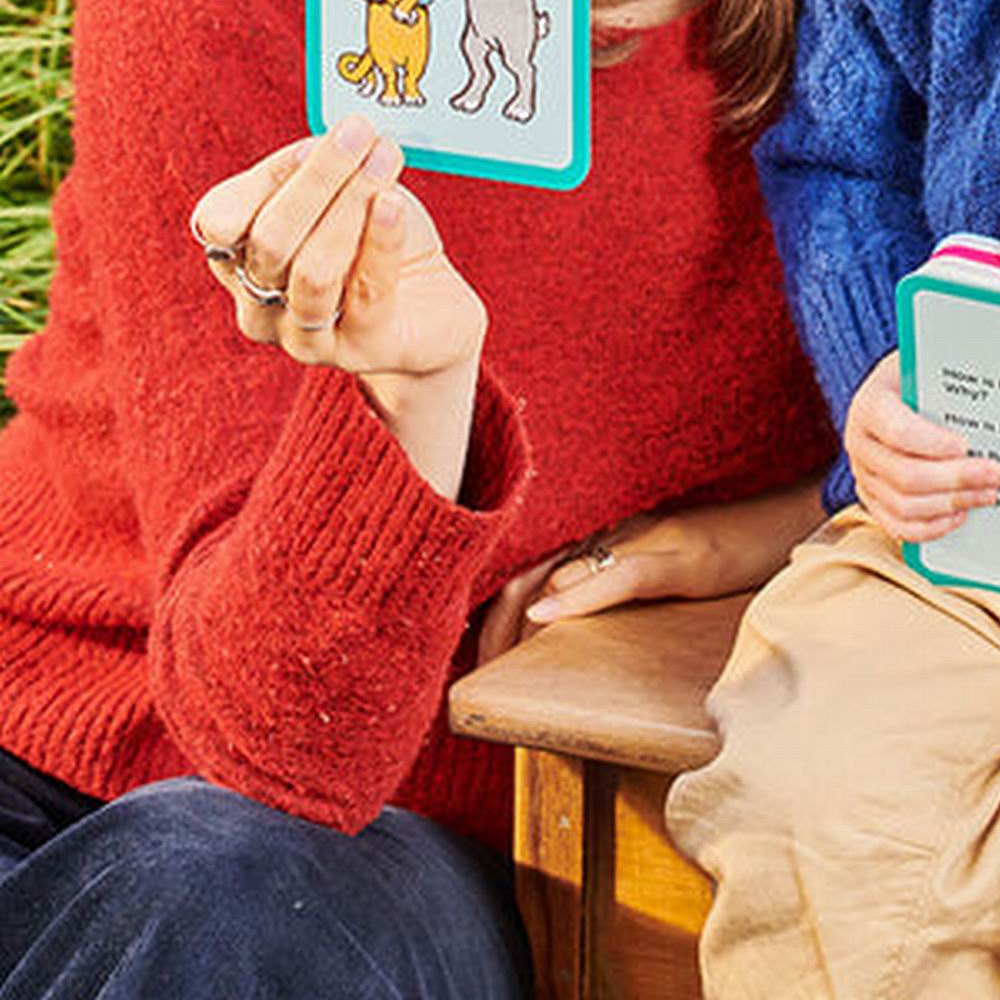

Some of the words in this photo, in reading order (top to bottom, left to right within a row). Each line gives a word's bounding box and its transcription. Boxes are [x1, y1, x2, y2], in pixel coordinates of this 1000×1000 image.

[942, 366, 979, 384] How
[981, 376, 996, 389] is
[943, 381, 989, 402] Why?
[944, 412, 980, 429] How
[982, 420, 996, 433] is
